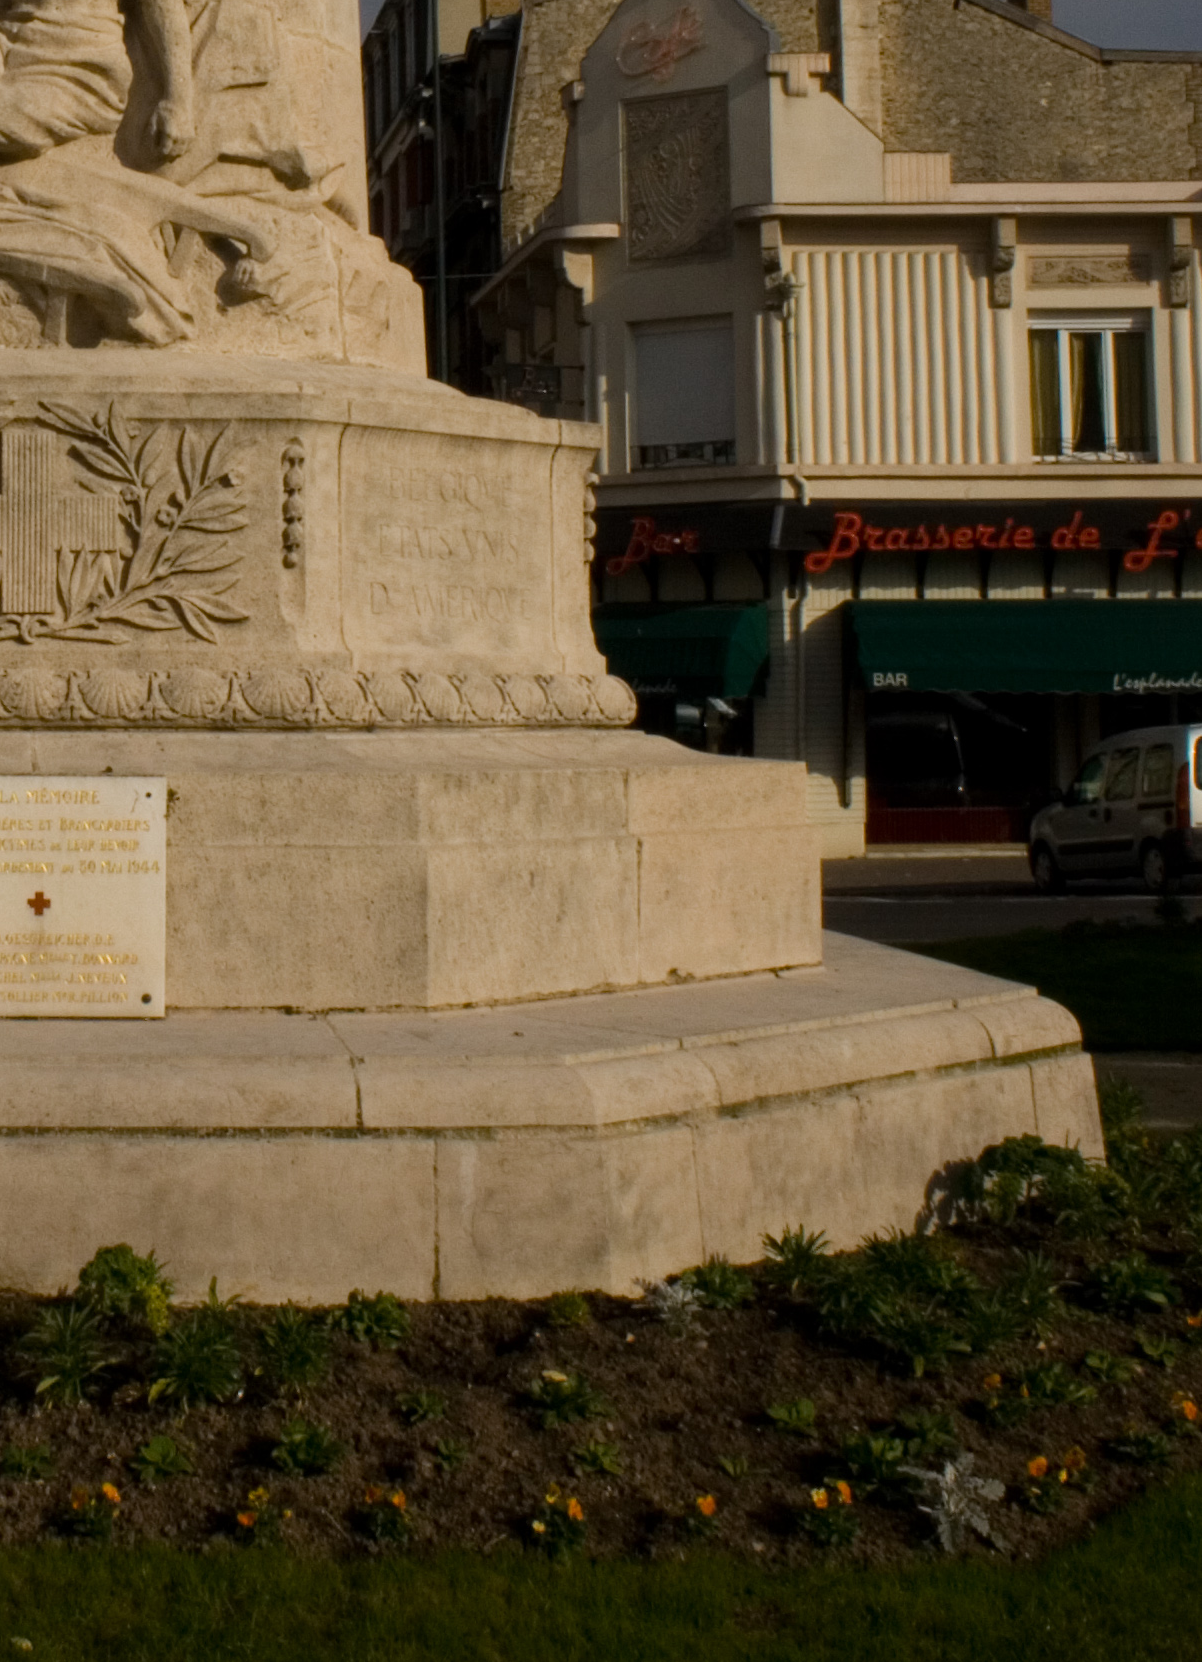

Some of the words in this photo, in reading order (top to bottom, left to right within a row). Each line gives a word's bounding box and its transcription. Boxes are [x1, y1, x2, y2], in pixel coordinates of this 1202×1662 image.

[605, 515, 700, 577] Bar
[805, 510, 1037, 574] Brasserie
[1050, 509, 1102, 551] de
[872, 672, 908, 688] BAR
[0, 790, 20, 805] LA
[25, 787, 101, 805] MÉMOIRE
[38, 819, 52, 832] ET
[66, 838, 95, 852] LEUR
[100, 839, 140, 852] DEVOIR
[127, 859, 161, 874] 1944
